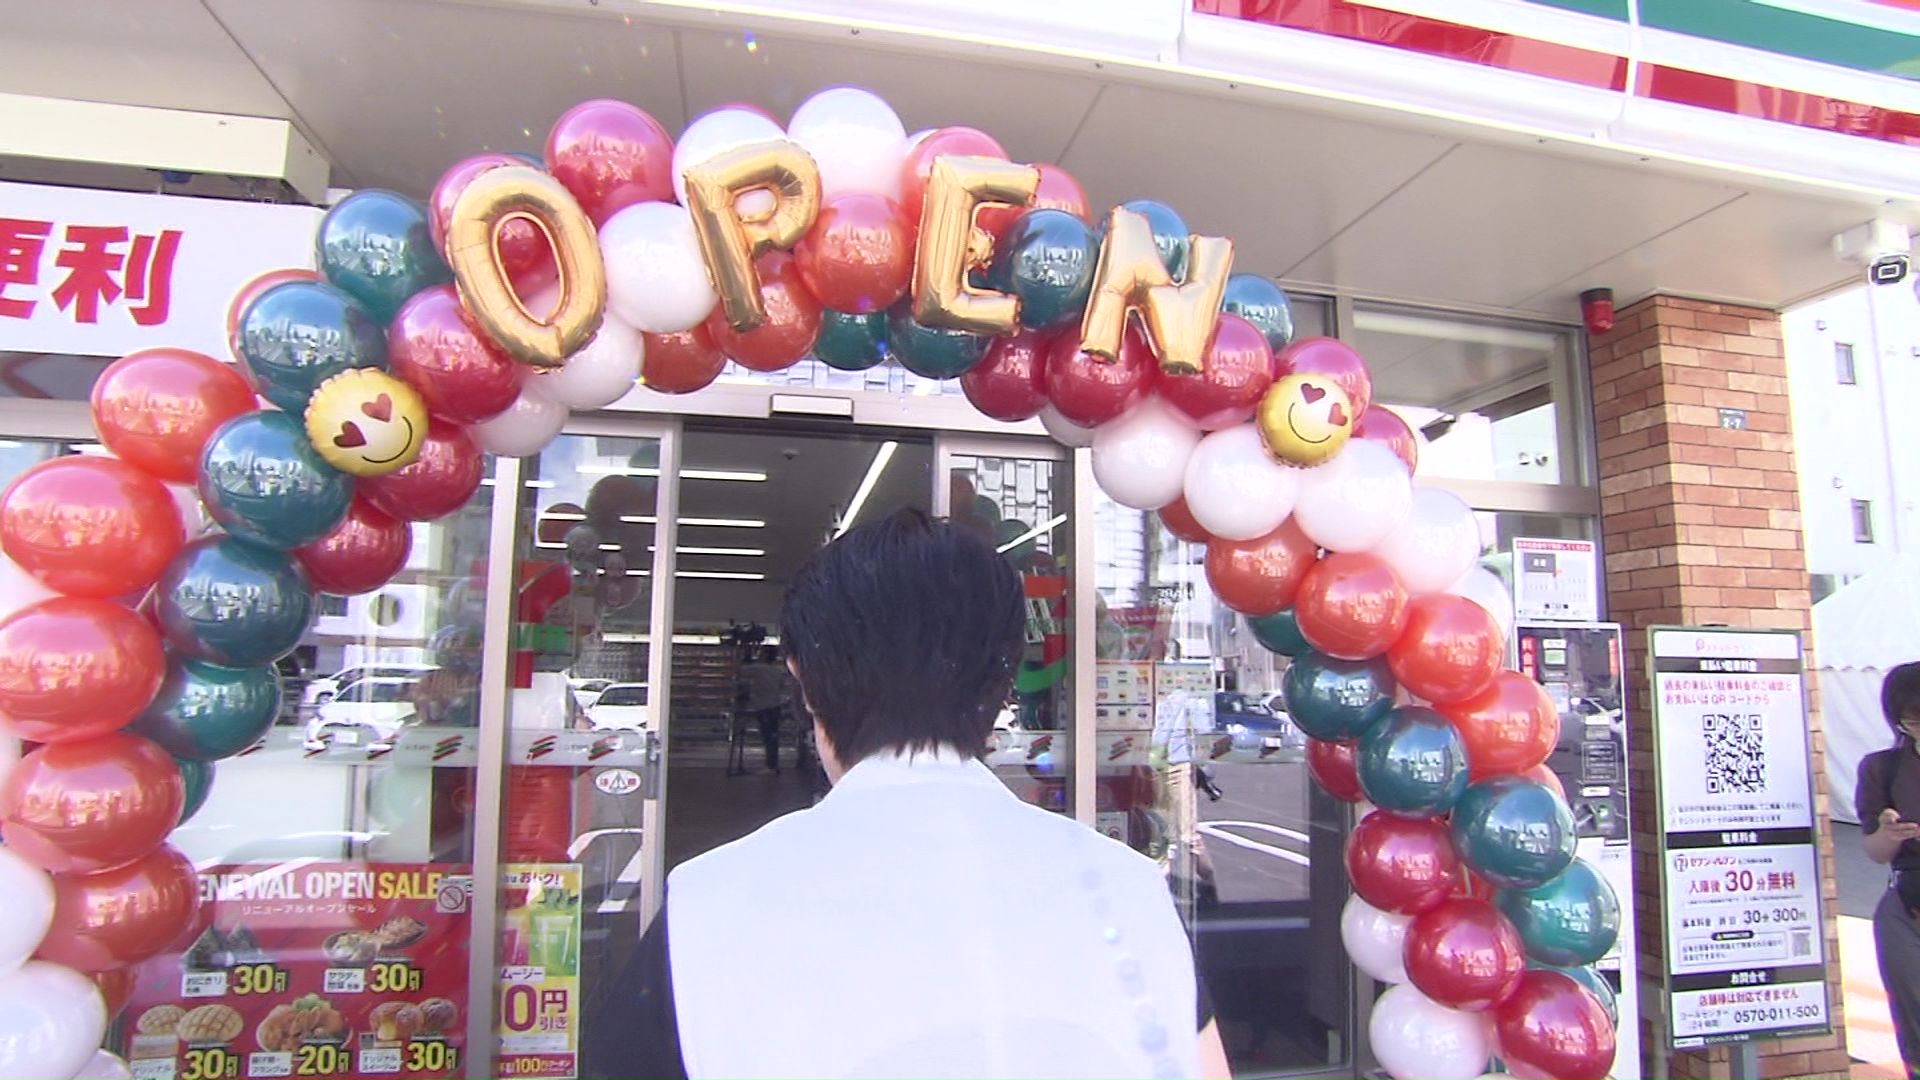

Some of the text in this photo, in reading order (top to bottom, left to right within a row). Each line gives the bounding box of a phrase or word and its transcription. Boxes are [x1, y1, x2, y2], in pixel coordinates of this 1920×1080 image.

[449, 138, 1235, 375] OPEN
[198, 871, 443, 901] ENEWAL OPEN SALE
[501, 968, 543, 980] ムージー
[1734, 1004, 1819, 1023] 0570-011-500
